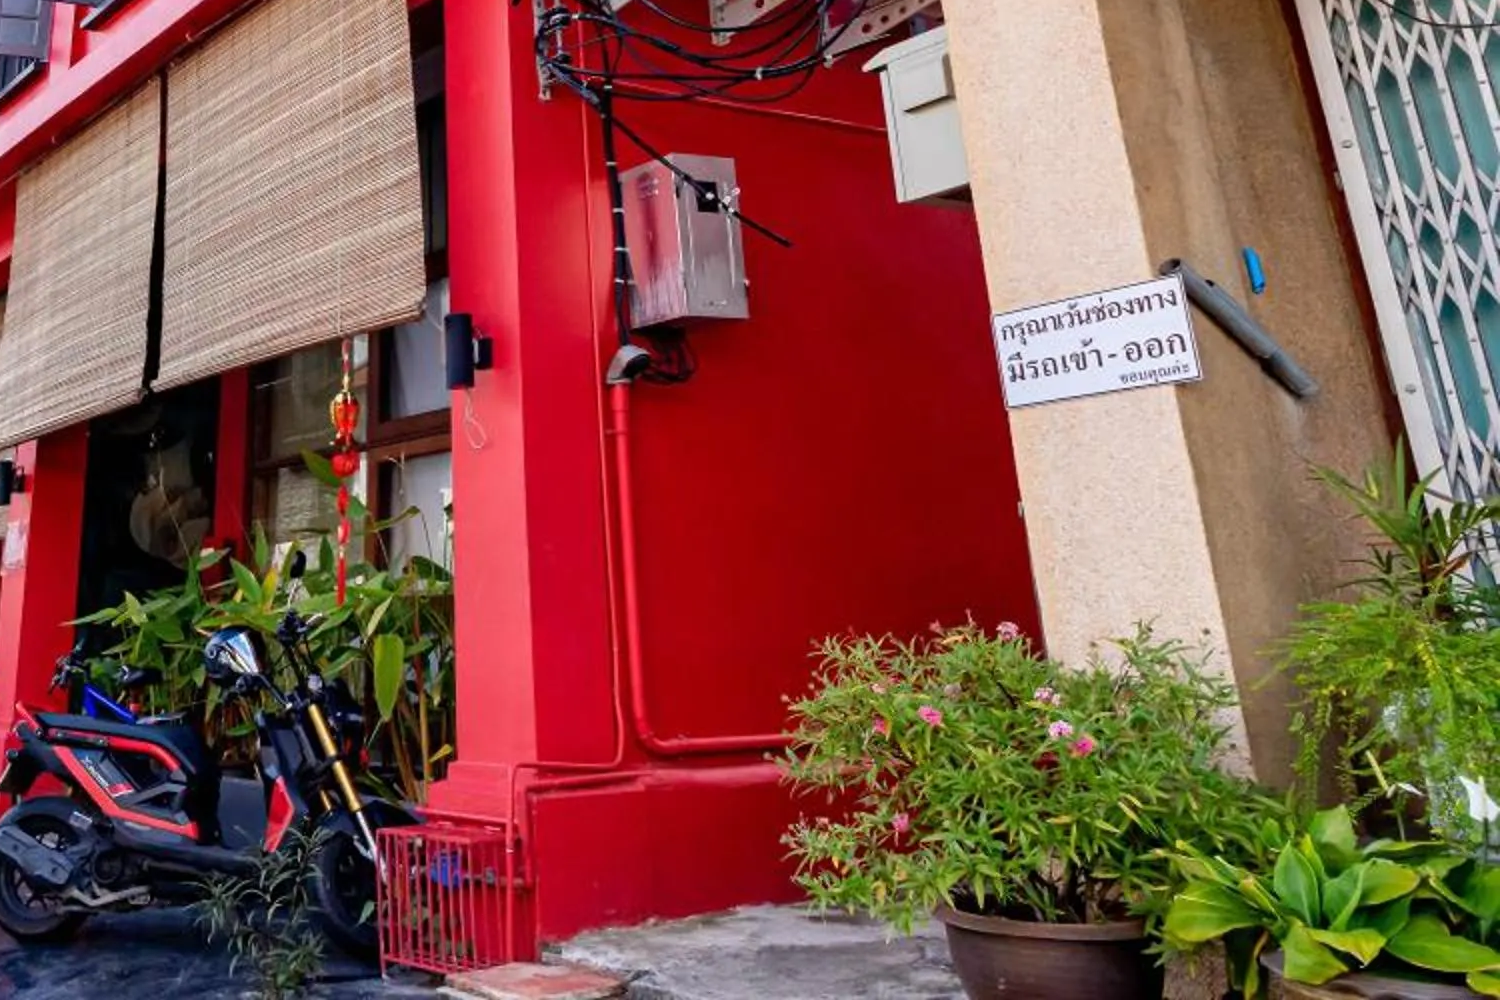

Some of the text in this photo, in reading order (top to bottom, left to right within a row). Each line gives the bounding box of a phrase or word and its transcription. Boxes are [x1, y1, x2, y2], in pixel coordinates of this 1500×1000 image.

[1001, 288, 1178, 346] กรุณาเว้นช่องทาง
[1007, 337, 1104, 383] มีรถเข้า
[1124, 331, 1187, 363] ออก
